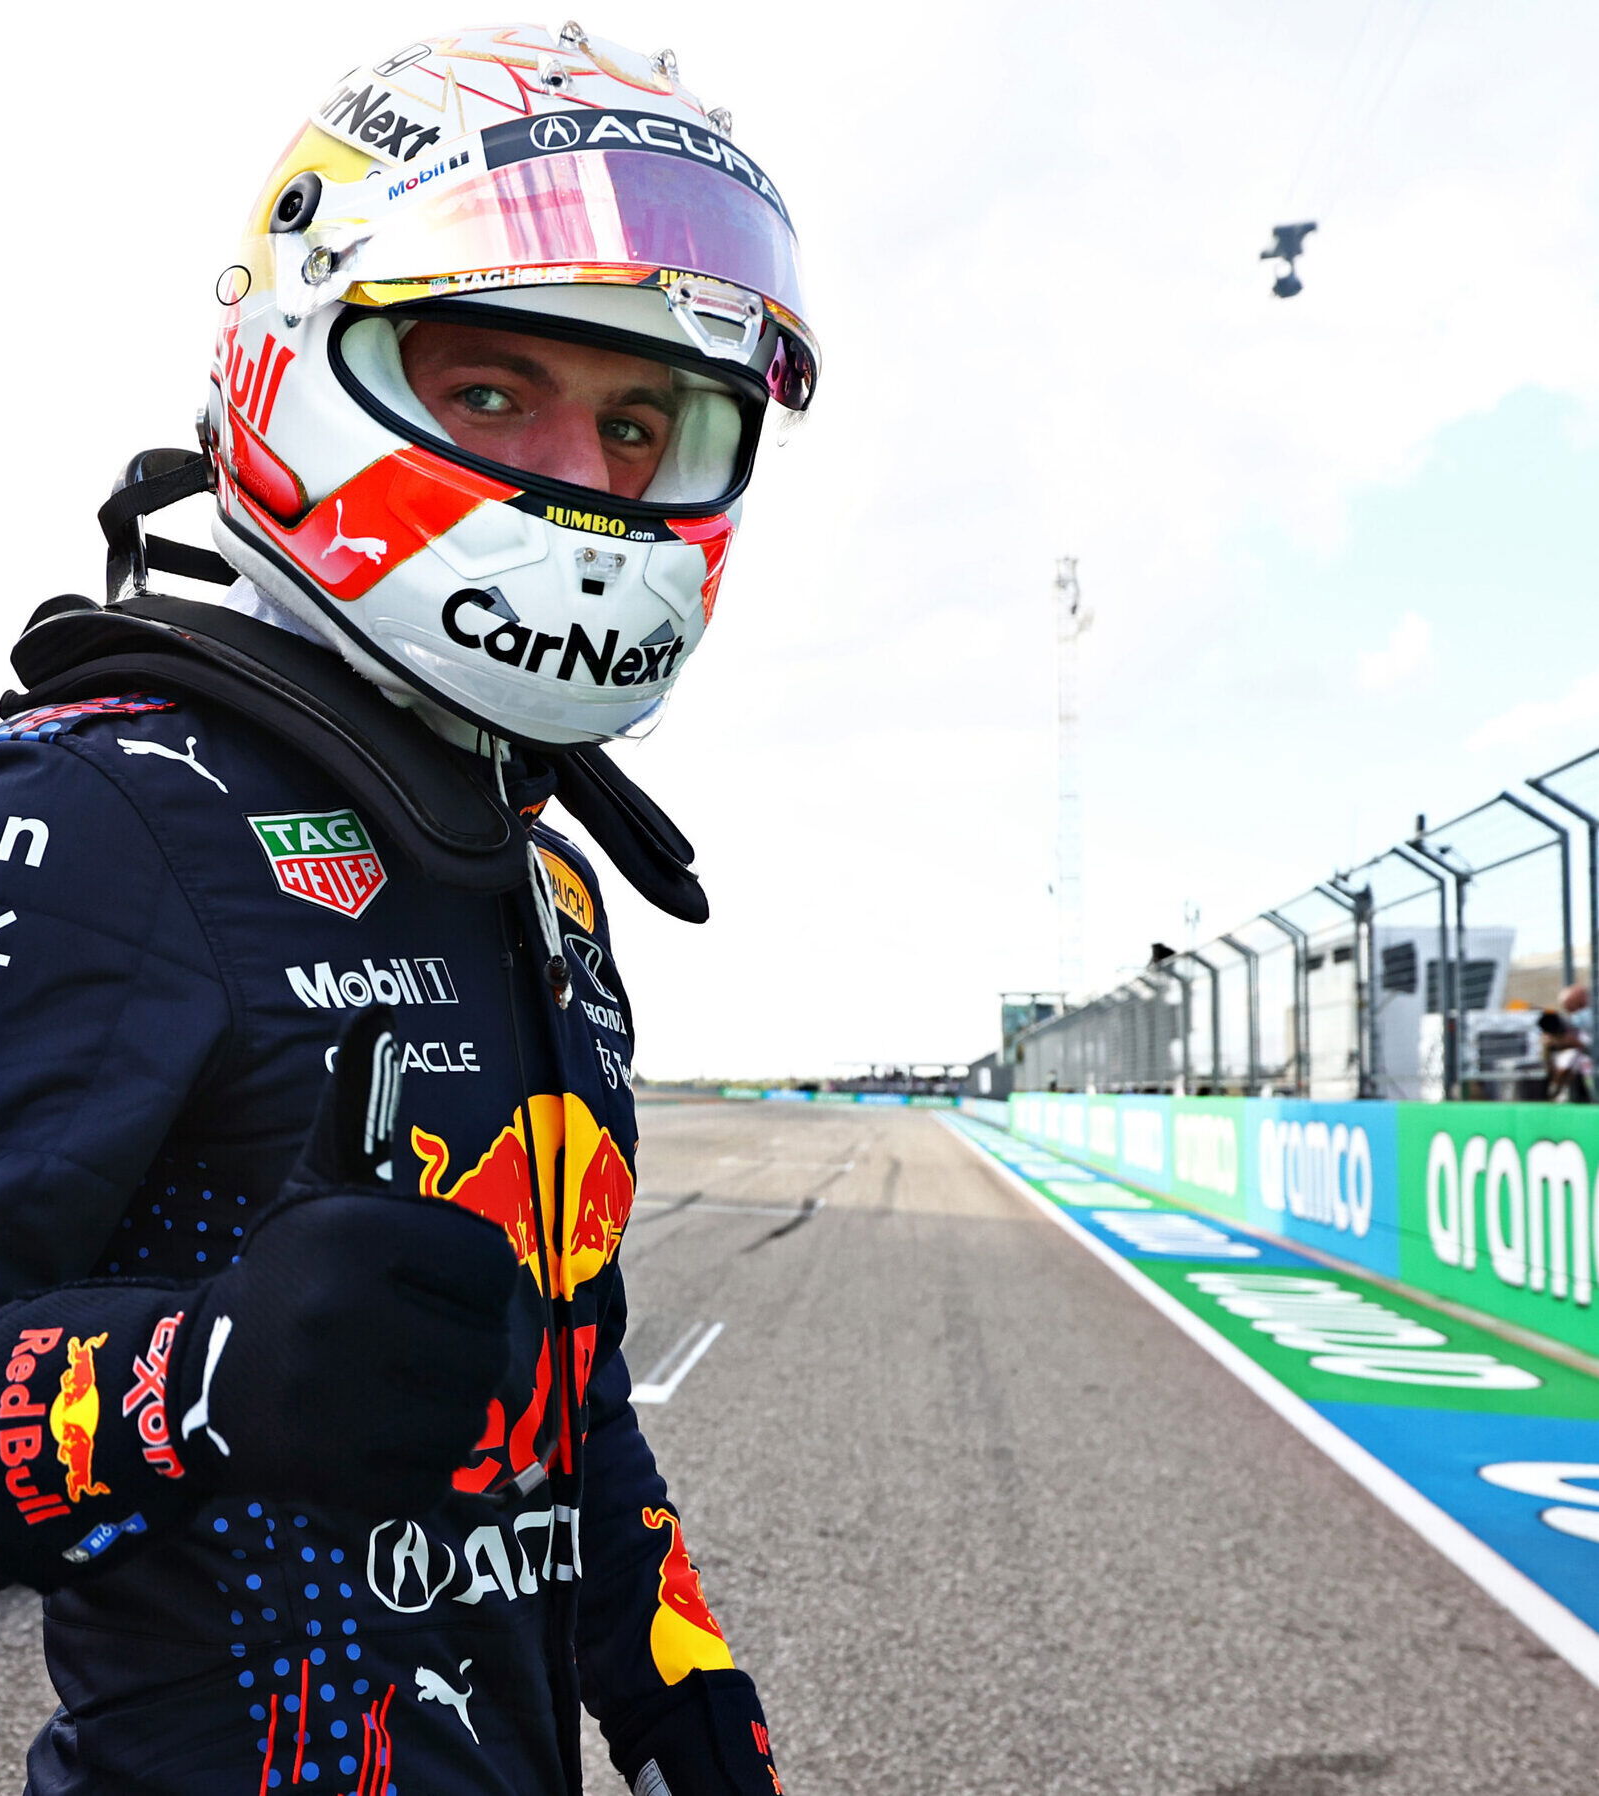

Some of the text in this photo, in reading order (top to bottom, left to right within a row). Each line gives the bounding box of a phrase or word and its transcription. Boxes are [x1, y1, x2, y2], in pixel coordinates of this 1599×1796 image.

[318, 80, 441, 162] rNext
[388, 161, 435, 200] Mobil
[442, 588, 685, 686] CarNext
[261, 818, 362, 852] TAG
[281, 857, 379, 910] HEUER
[545, 868, 586, 925] AUCH
[285, 959, 424, 1008] Mobil
[580, 1000, 628, 1035] HON
[324, 1042, 481, 1074] ACLE
[1259, 1117, 1373, 1239] aramco
[1425, 1130, 1599, 1309] aram
